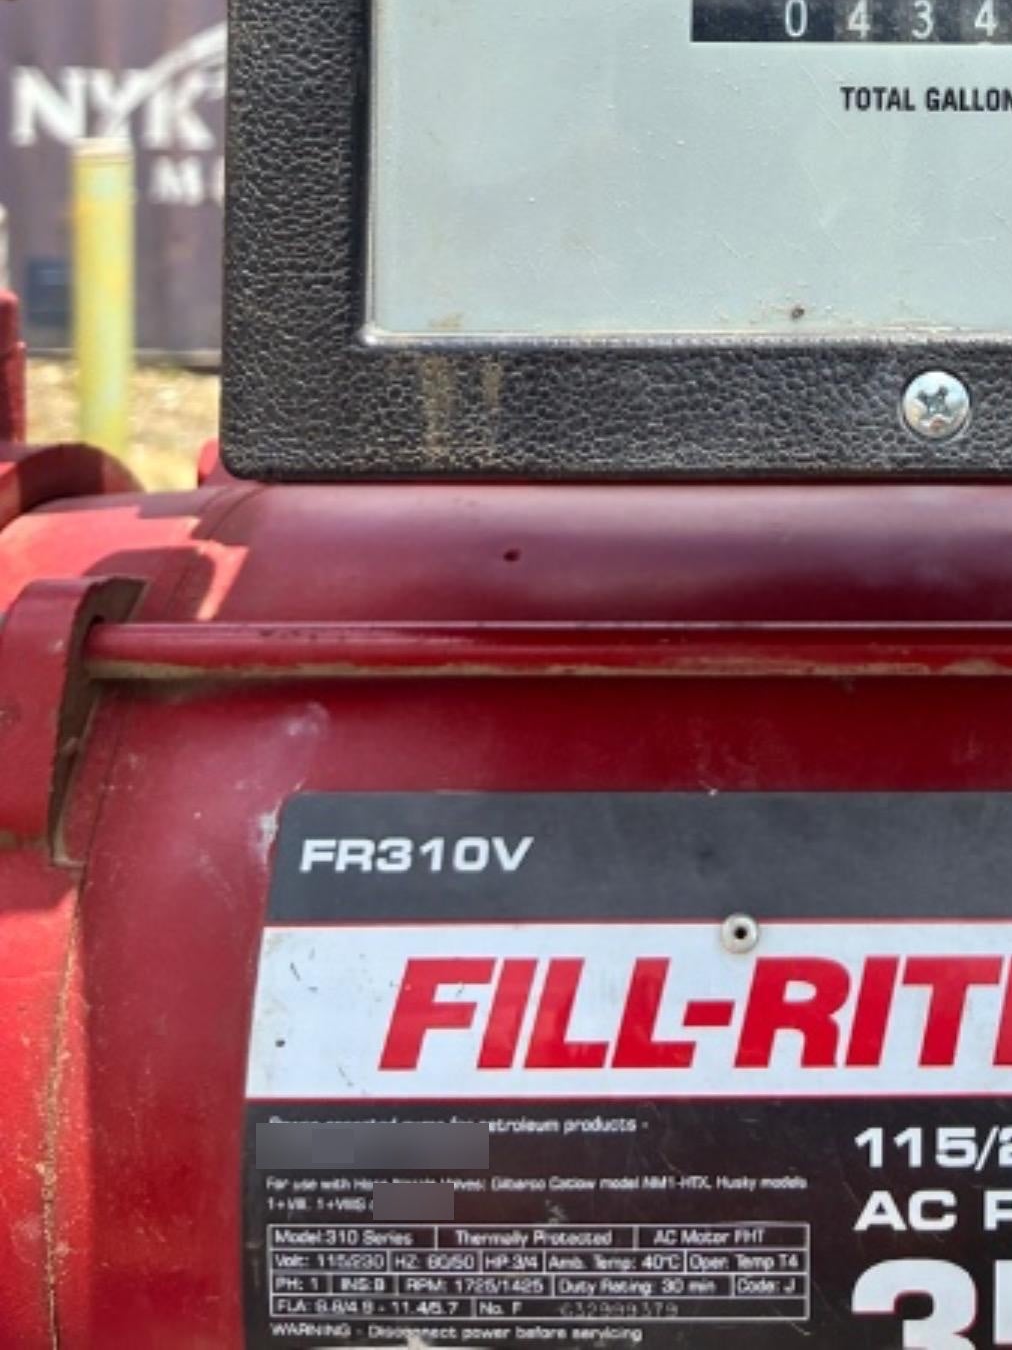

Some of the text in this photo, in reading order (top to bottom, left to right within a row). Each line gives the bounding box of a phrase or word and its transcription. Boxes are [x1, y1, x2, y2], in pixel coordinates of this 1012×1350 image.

[840, 85, 916, 112] TOTAL
[300, 836, 536, 872] FR310V
[563, 1114, 637, 1135] products
[853, 1189, 958, 1232] AC
[362, 1229, 413, 1246] Series
[455, 1228, 613, 1249] Thermally Protected
[653, 1228, 678, 1245] AC
[681, 1228, 730, 1245] Motor
[735, 1252, 775, 1272] Temp
[557, 1276, 596, 1297] Duty
[660, 1276, 685, 1293] 30
[688, 1276, 718, 1293] min
[461, 1326, 513, 1343] power
[515, 1324, 568, 1340] before
[571, 1324, 644, 1344] servicing
